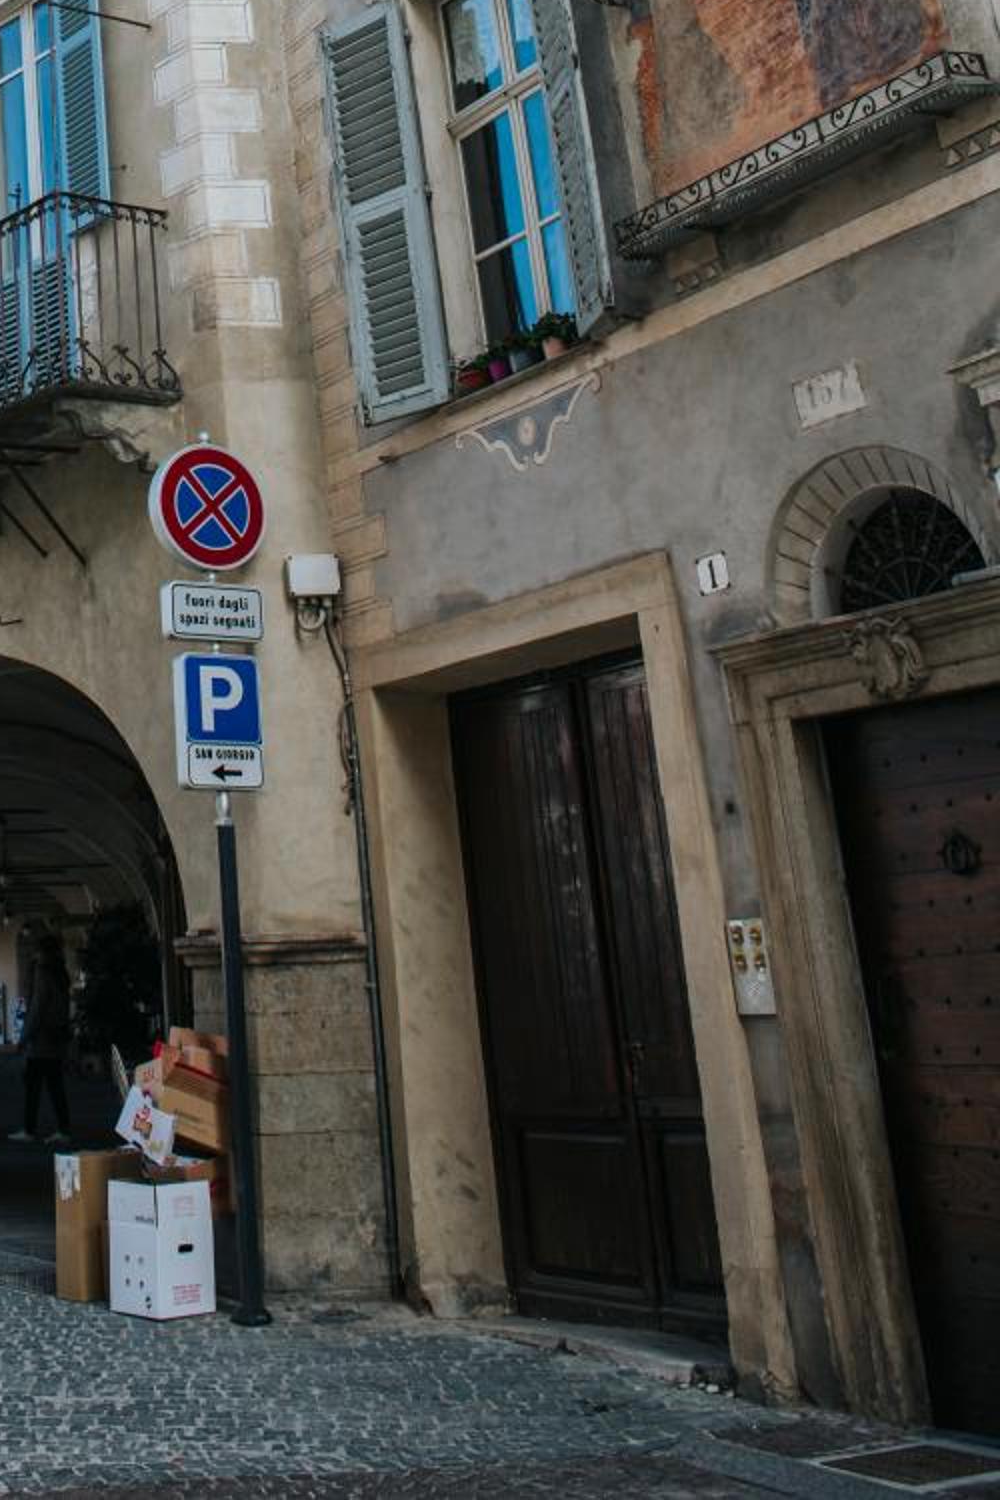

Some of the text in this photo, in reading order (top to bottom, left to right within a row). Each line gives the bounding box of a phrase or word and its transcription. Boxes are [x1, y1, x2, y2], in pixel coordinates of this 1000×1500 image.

[708, 560, 719, 588] 1
[185, 593, 249, 612] fuori dagli
[179, 613, 255, 629] spazi segnati
[200, 666, 244, 732] P
[195, 748, 255, 760] SAN GIORGIO
